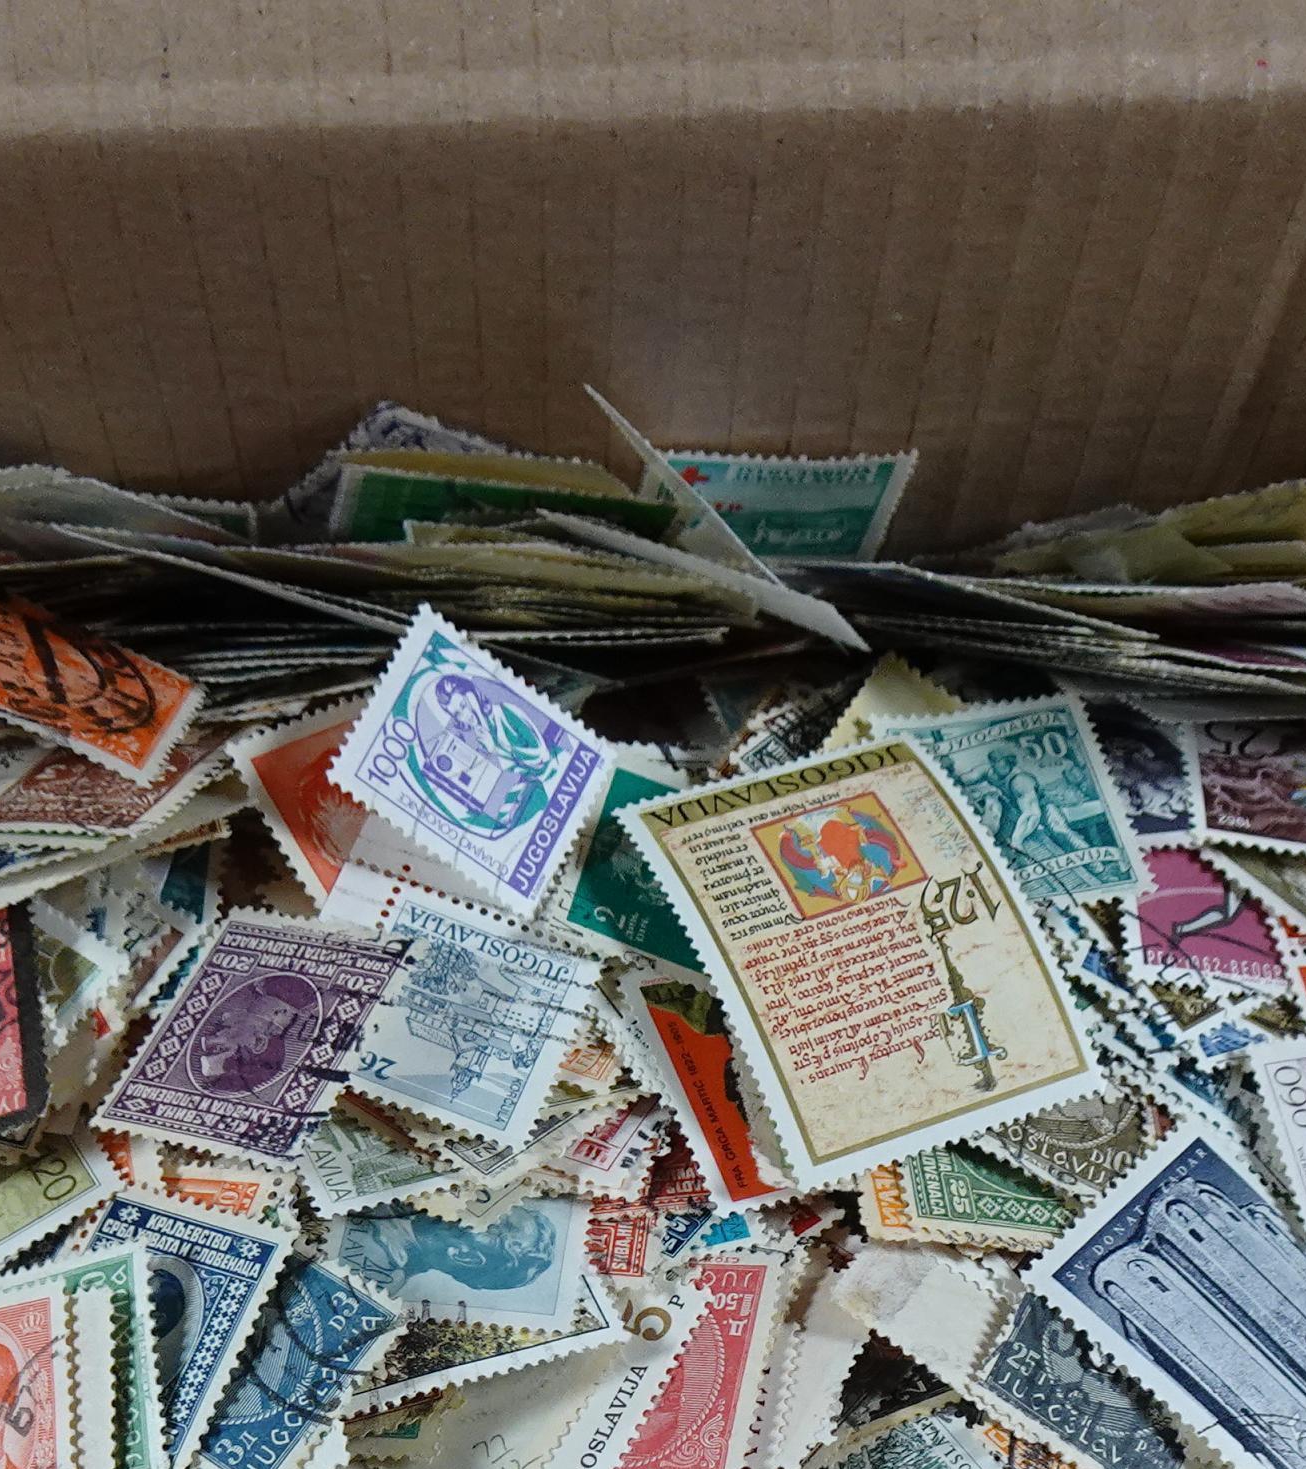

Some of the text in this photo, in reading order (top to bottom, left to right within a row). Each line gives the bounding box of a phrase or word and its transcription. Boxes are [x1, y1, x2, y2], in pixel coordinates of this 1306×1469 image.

[363, 719, 421, 789] 1000
[1018, 728, 1068, 760] 50
[647, 746, 907, 828] JUGOSLAVIJA
[512, 745, 600, 900] JUGOSLAVIJA
[404, 903, 571, 986] JUGOSLAVIJA
[358, 1050, 400, 1081] 26
[948, 1177, 967, 1214] 25
[144, 1212, 233, 1252] КРАЉЕВСТВО
[1091, 1204, 1147, 1257] DONAT
[1004, 1341, 1041, 1376] 25
